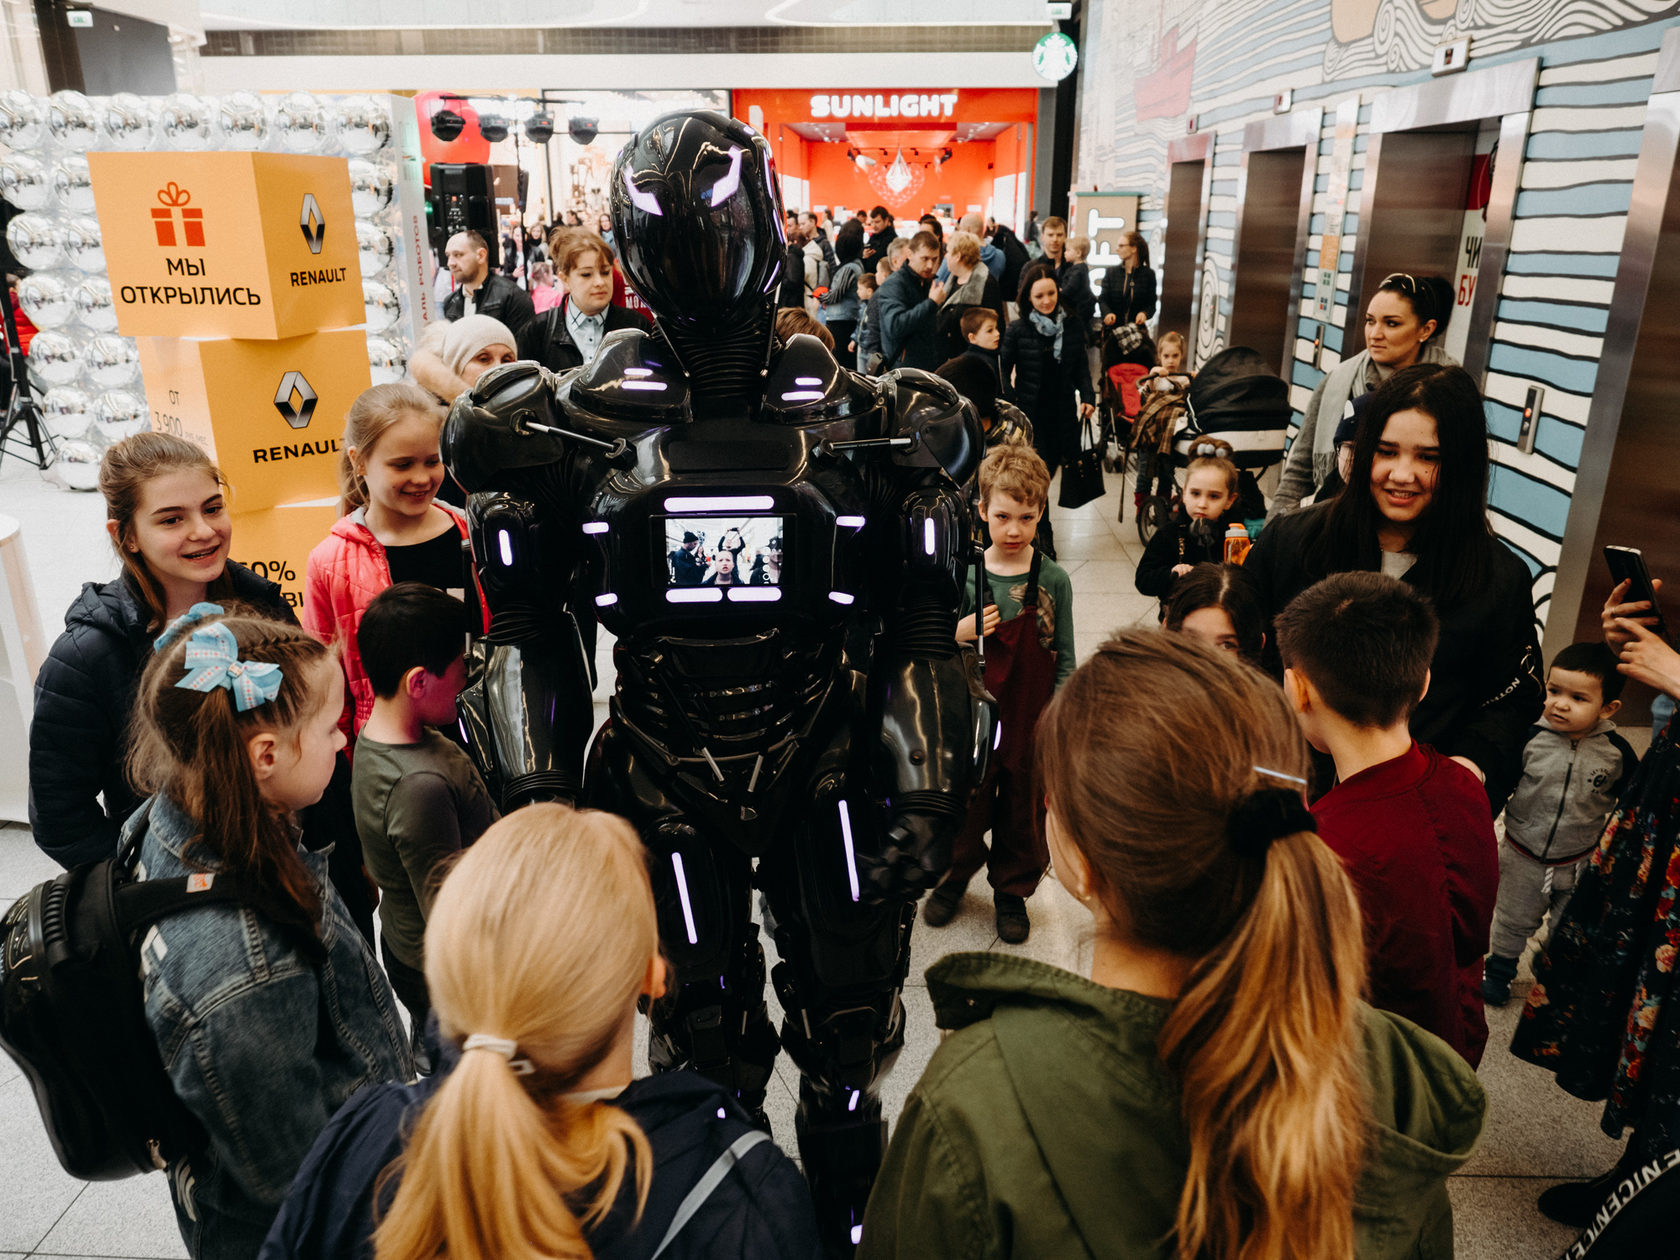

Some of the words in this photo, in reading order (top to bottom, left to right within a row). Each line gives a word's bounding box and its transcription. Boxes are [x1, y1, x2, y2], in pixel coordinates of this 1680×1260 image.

[810, 94, 958, 118] SUNLIGHT
[166, 258, 206, 276] МЫ
[290, 267, 347, 287] RENAULT
[120, 286, 261, 306] ОТКРЫЛИСЬ
[252, 438, 345, 464] RENAUL
[237, 560, 296, 582] 0%
